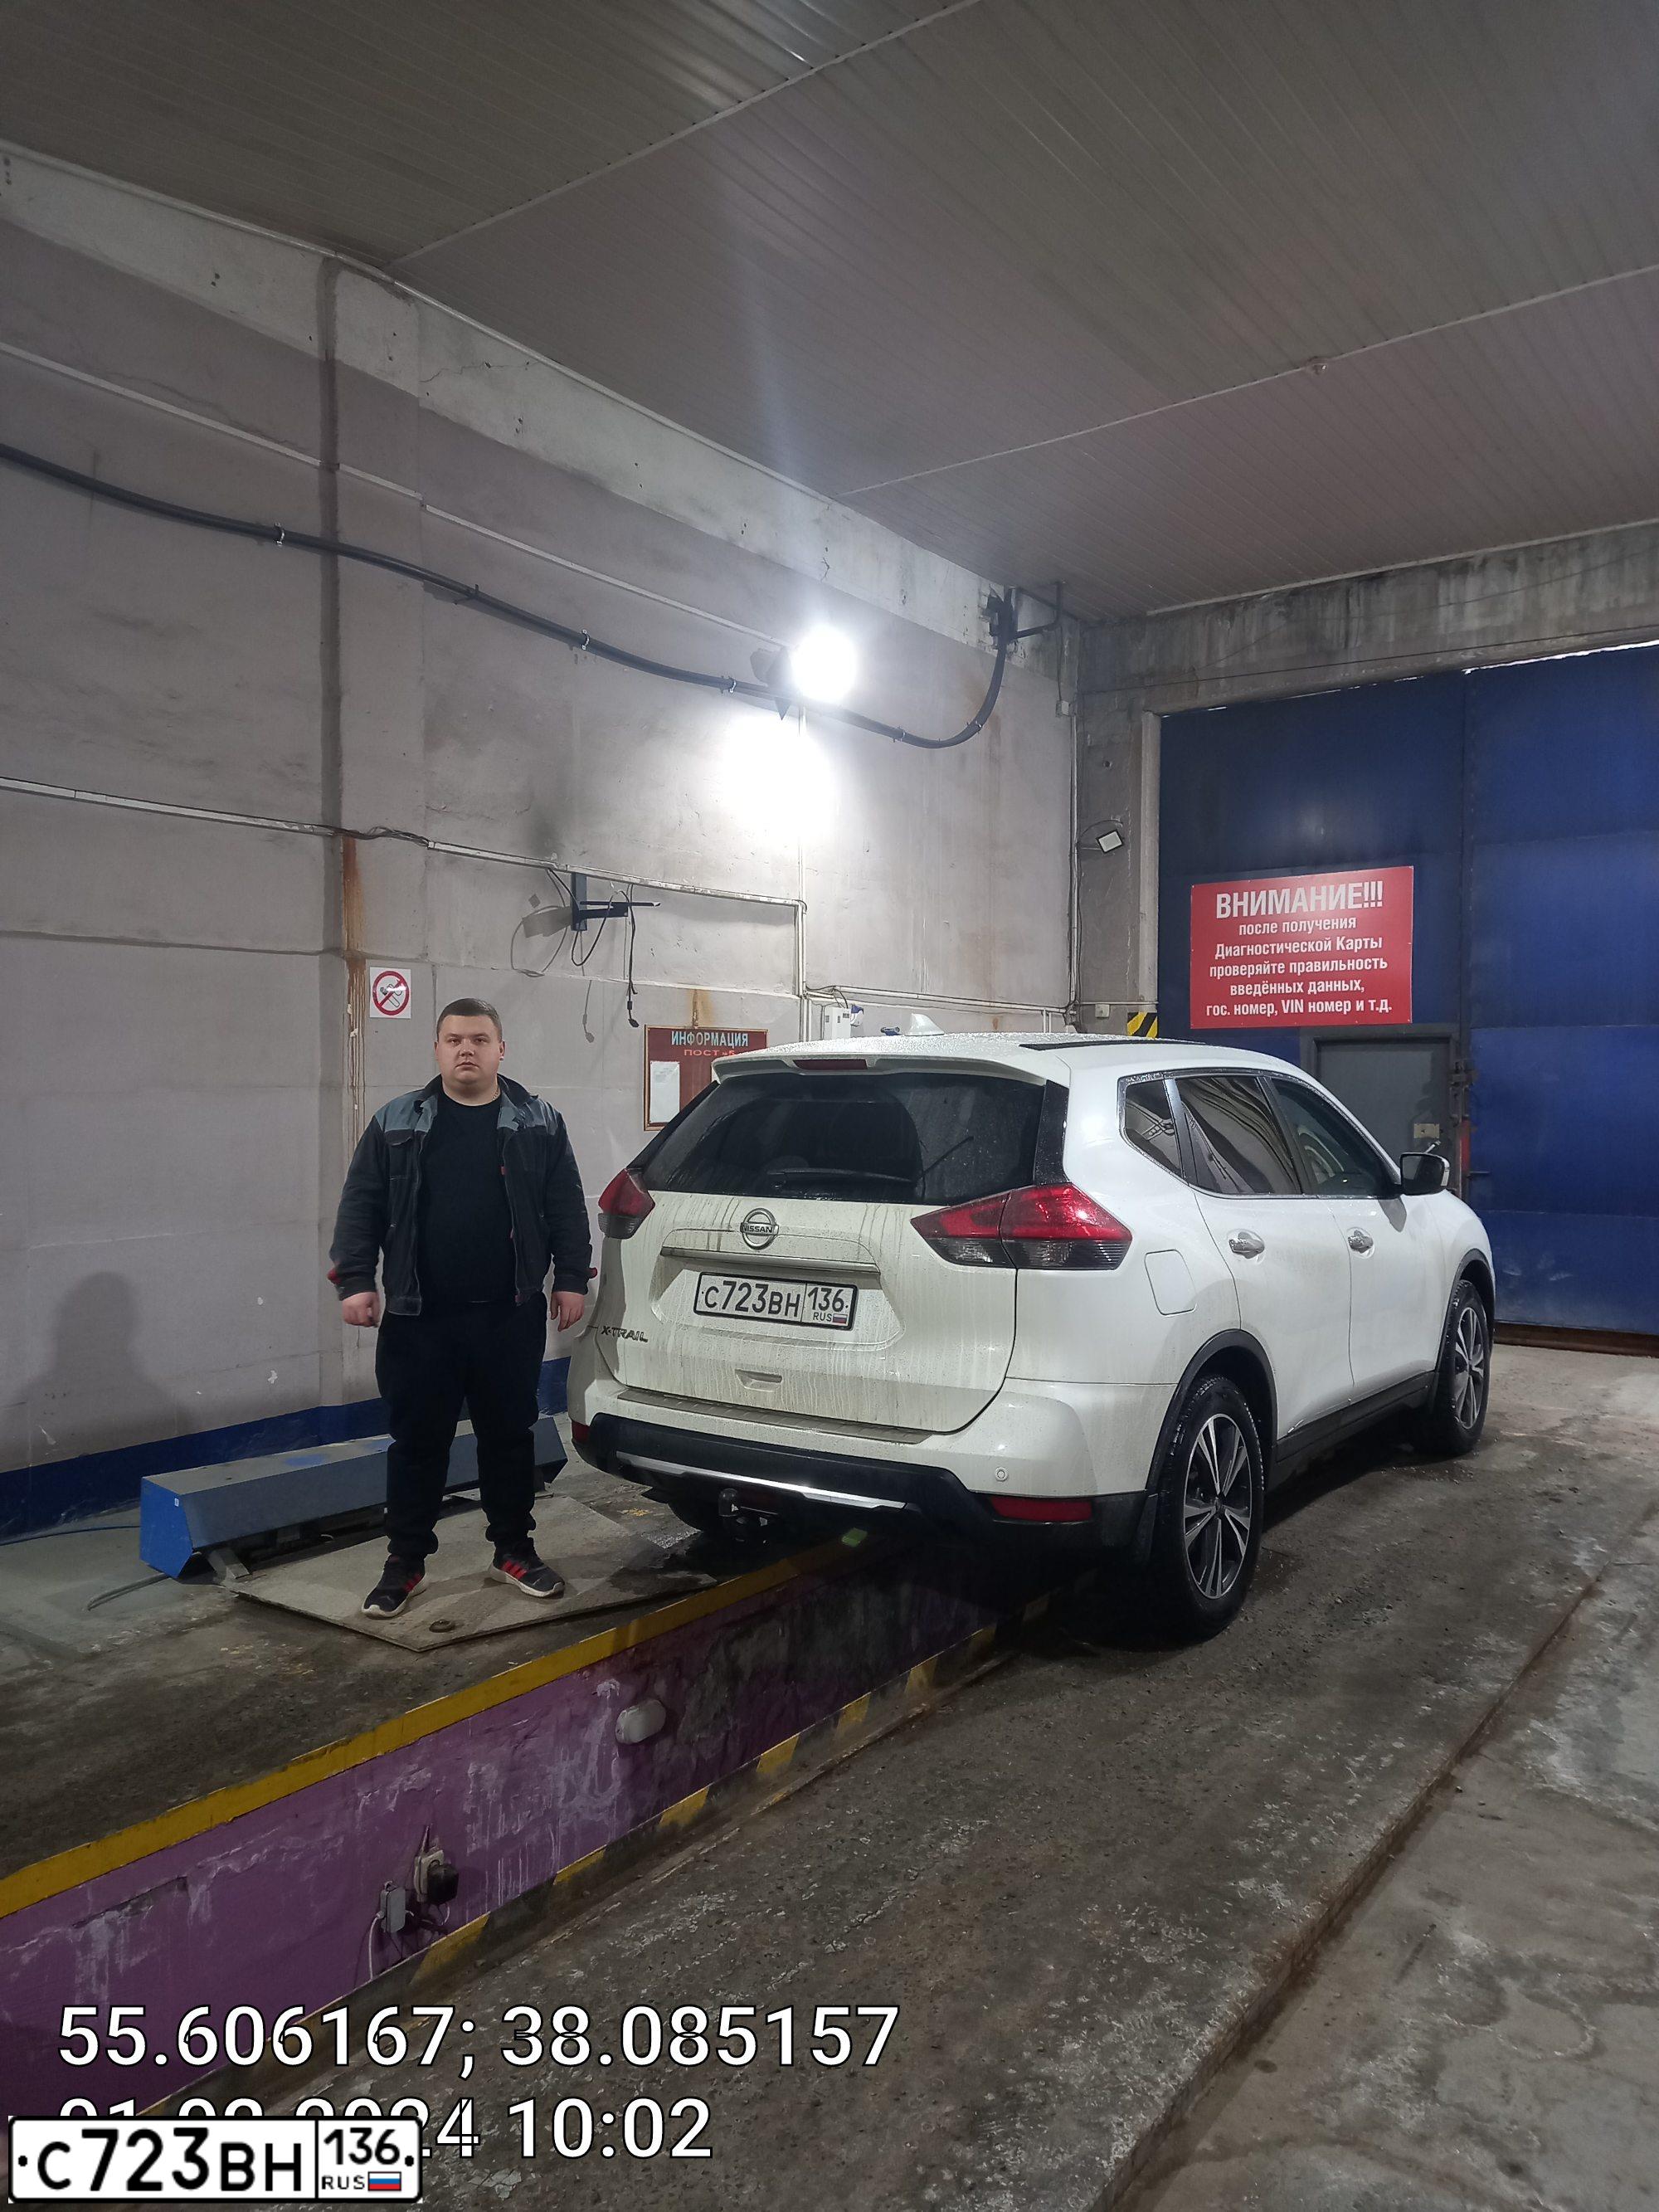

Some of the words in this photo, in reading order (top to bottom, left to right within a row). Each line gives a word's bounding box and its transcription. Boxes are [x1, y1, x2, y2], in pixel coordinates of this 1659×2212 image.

[1216, 880, 1384, 918] ВНИМАНИЕ!!!
[1238, 920, 1278, 936] после
[1282, 916, 1357, 934] получения
[1214, 937, 1332, 960] Диагностической
[1336, 937, 1383, 953] Карты
[1209, 960, 1286, 980] проверяйте
[1289, 956, 1389, 975] правильность
[1229, 977, 1304, 996] введённых
[1307, 977, 1365, 995] данных,
[1206, 1004, 1231, 1016] гос.
[1233, 1001, 1278, 1017] номер,
[1281, 999, 1305, 1013] VIN
[1308, 998, 1352, 1015] номер
[1355, 998, 1365, 1011] и
[1368, 998, 1393, 1015] т.д.
[671, 1030, 749, 1049] ИНФОРМАЦИЯ
[742, 1224, 773, 1234] NISSAN
[704, 1280, 801, 1318] С723ВН
[807, 1286, 844, 1313] 136
[812, 1312, 832, 1322] RUS
[601, 1325, 649, 1342] X-TRAIL
